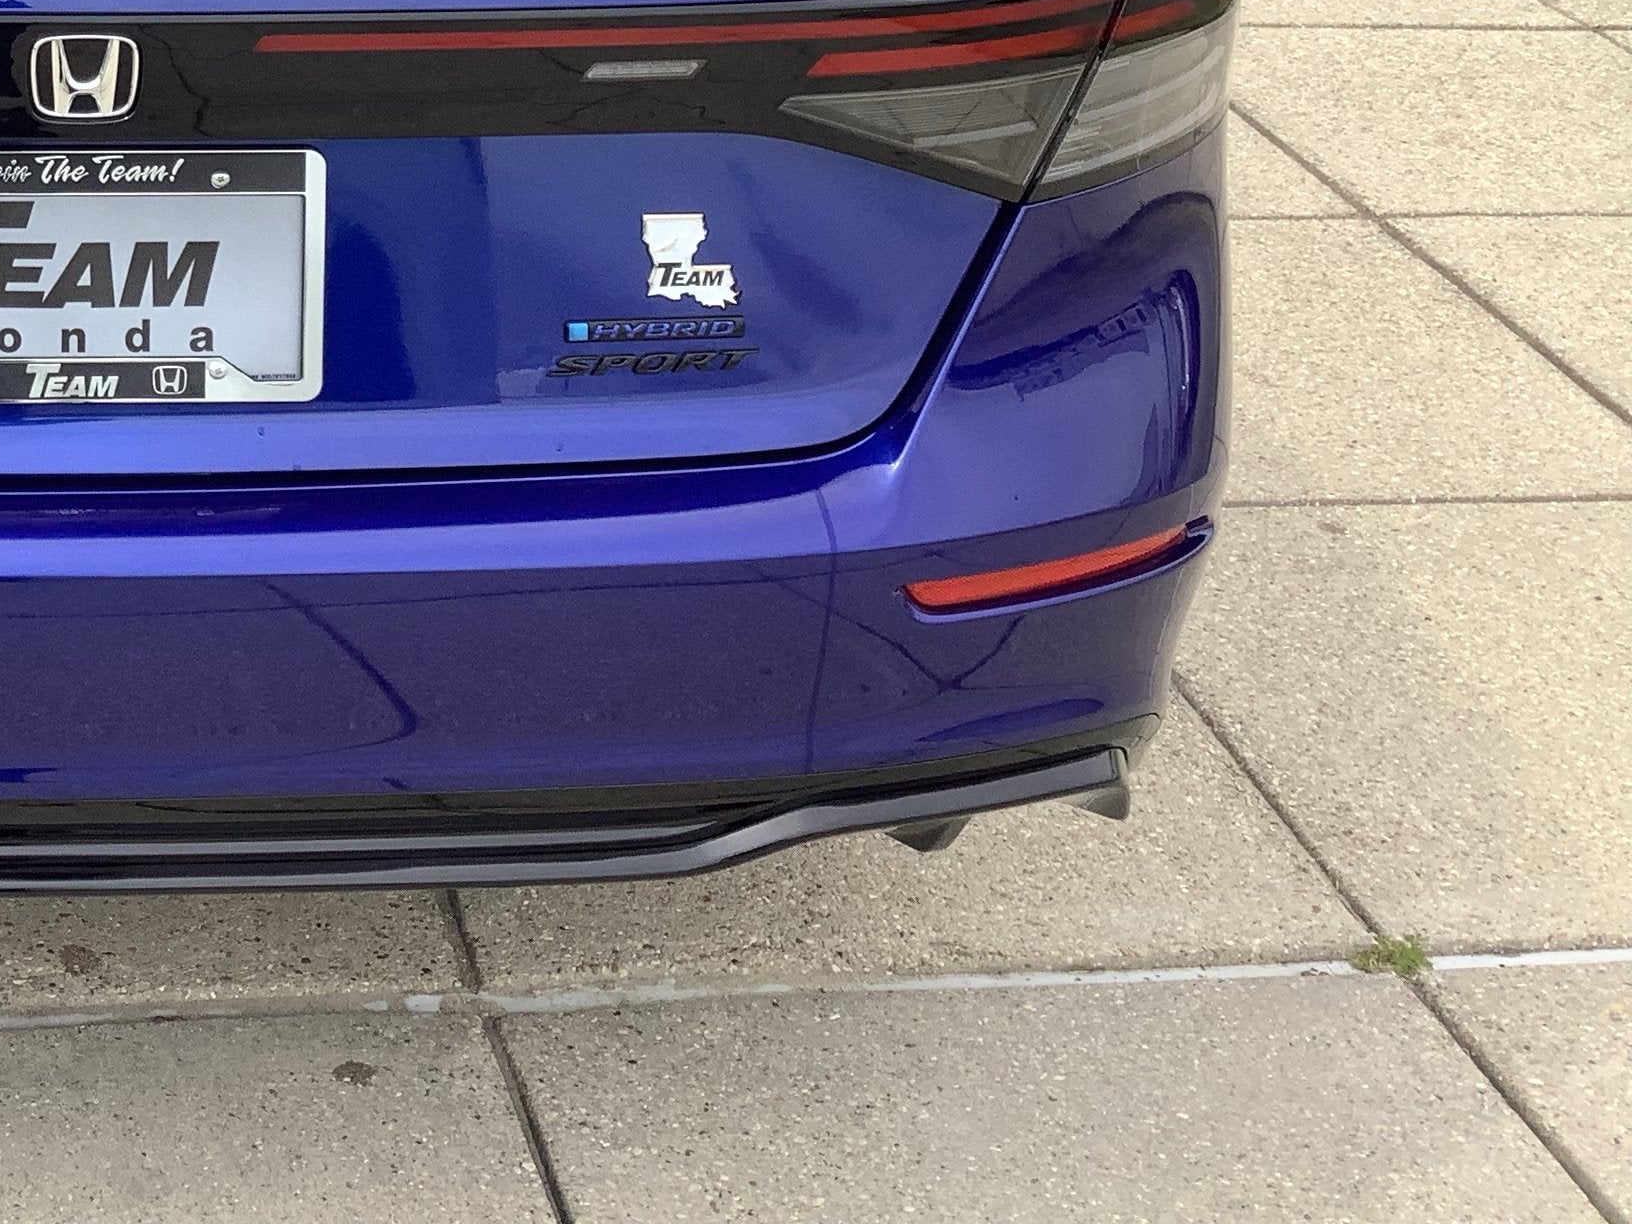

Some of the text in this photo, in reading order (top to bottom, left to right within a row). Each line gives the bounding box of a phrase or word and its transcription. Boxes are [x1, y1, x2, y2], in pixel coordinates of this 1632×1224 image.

[35, 155, 89, 184] The
[92, 155, 185, 184] Team!
[655, 262, 725, 287] TEAM
[592, 321, 736, 339] HYBRID
[546, 348, 760, 377] SPORT
[25, 363, 119, 398] TEAM
